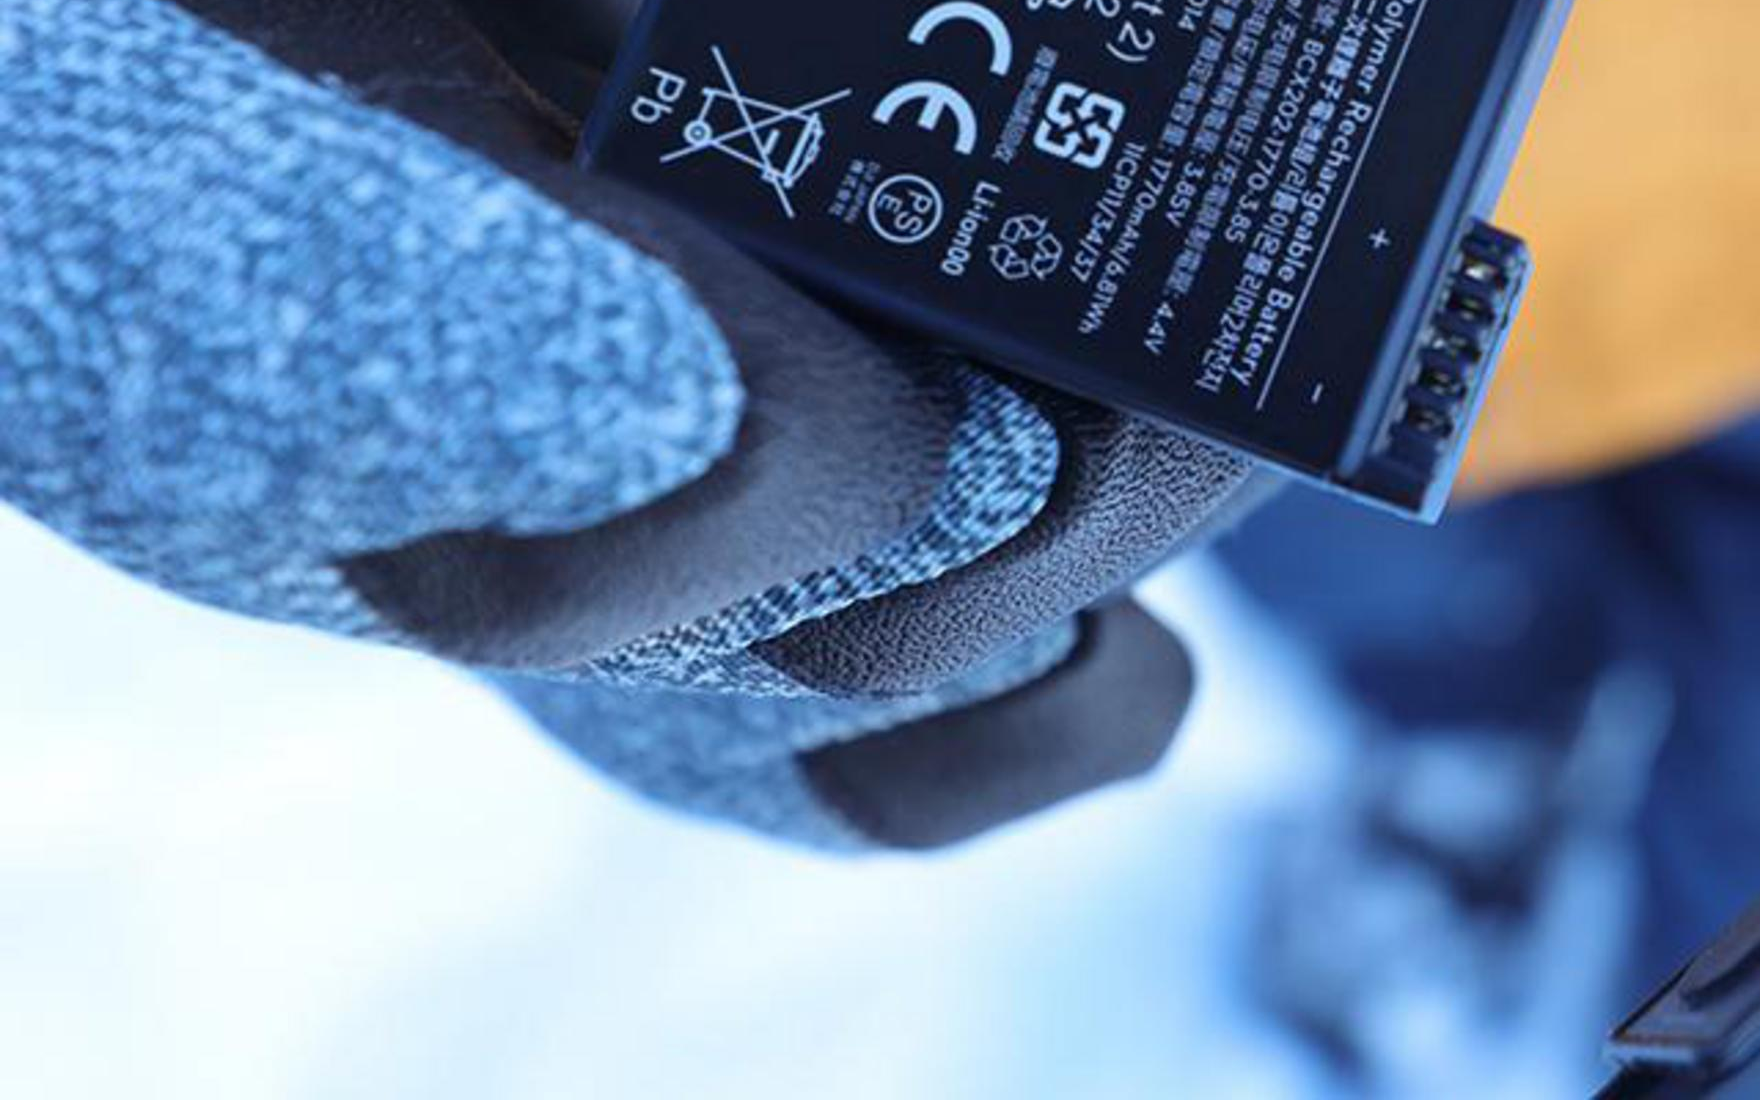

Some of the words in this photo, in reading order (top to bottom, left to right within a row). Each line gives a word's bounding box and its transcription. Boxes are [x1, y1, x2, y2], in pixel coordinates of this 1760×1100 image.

[871, 0, 1012, 155] CE
[1105, 20, 1155, 63] 2)
[629, 66, 687, 124] Pb
[1223, 37, 1325, 243] BCX202-1770-3.85
[1164, 160, 1205, 227] 3.85V
[1276, 98, 1373, 282] Rechargeable
[1077, 157, 1173, 334] 1770mAh/6.81Wh
[1143, 300, 1174, 354] 4.4V
[1228, 286, 1295, 386] Battery
